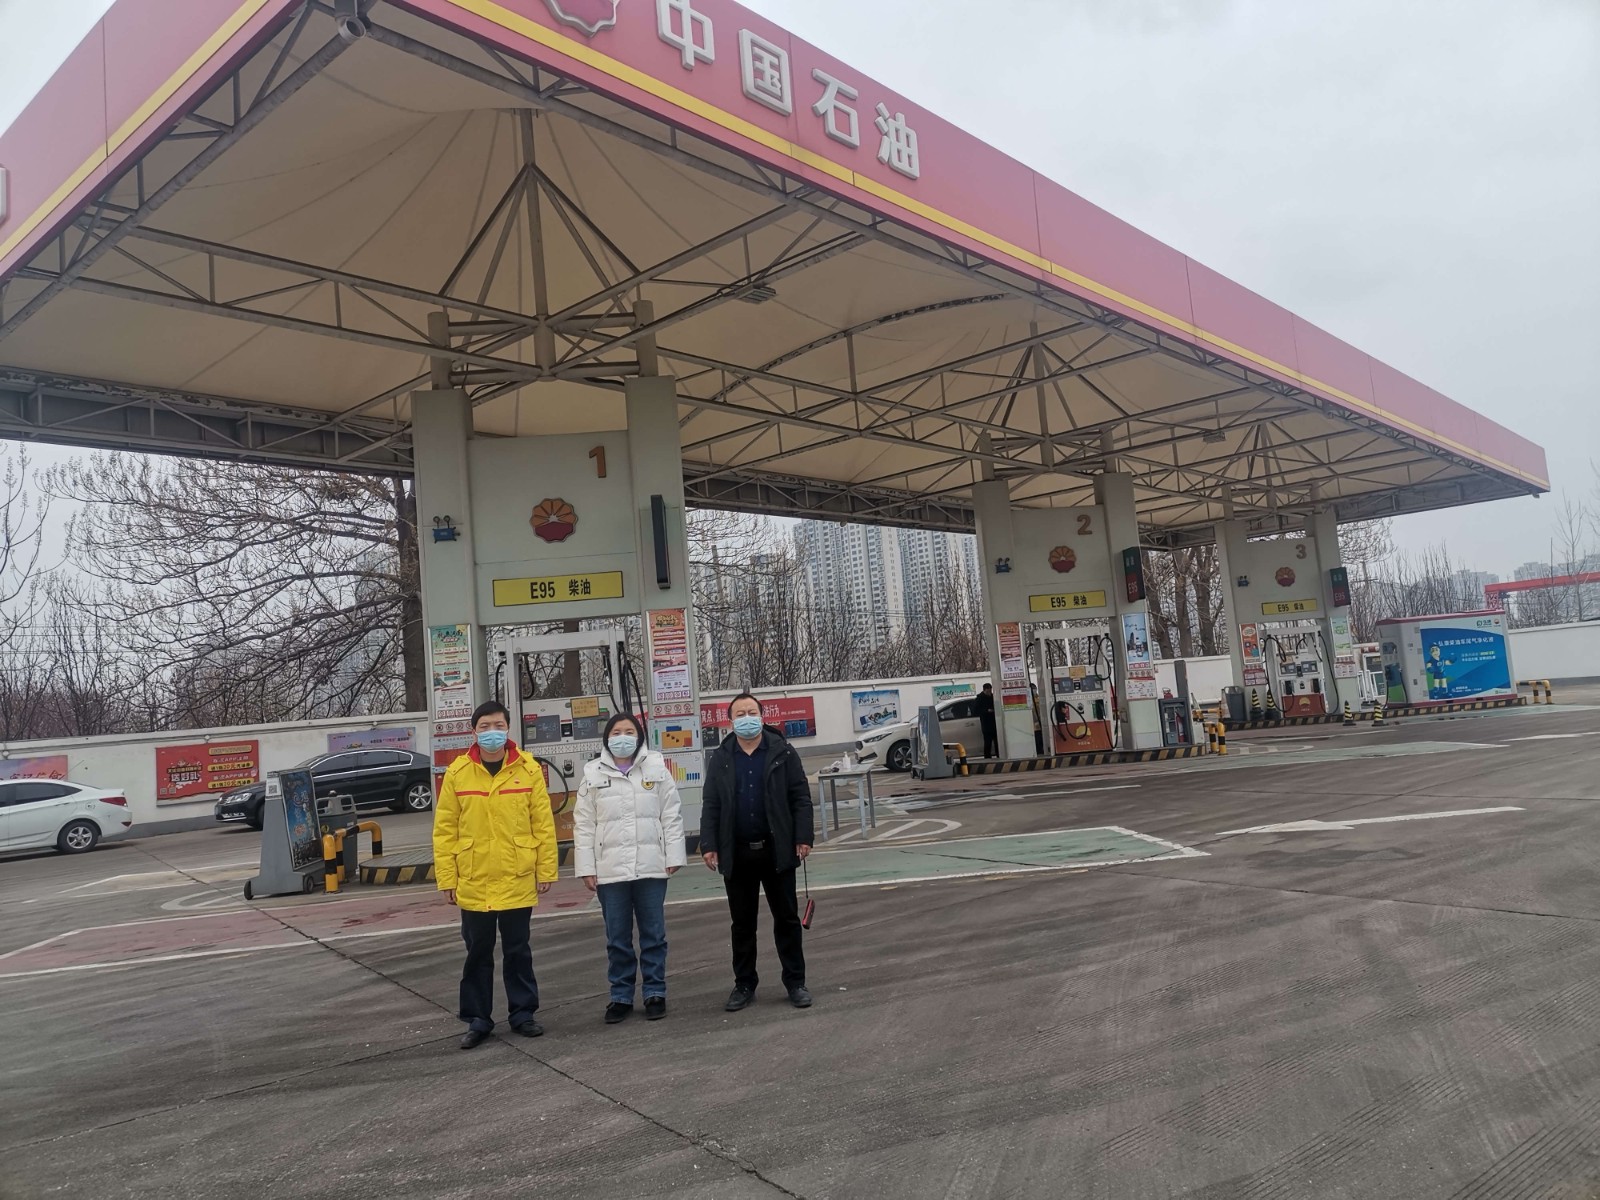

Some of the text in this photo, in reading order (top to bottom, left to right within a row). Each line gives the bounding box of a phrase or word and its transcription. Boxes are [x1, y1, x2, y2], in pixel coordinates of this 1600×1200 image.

[656, 0, 920, 180] 中国石油
[588, 445, 607, 479] 1
[1076, 514, 1093, 536] 2
[1295, 543, 1307, 560] 3
[530, 578, 592, 600] E95 柴油
[1127, 580, 1138, 595] E95
[1050, 594, 1088, 609] E95 柴油
[1334, 591, 1346, 602] E95
[1277, 603, 1290, 612] E95
